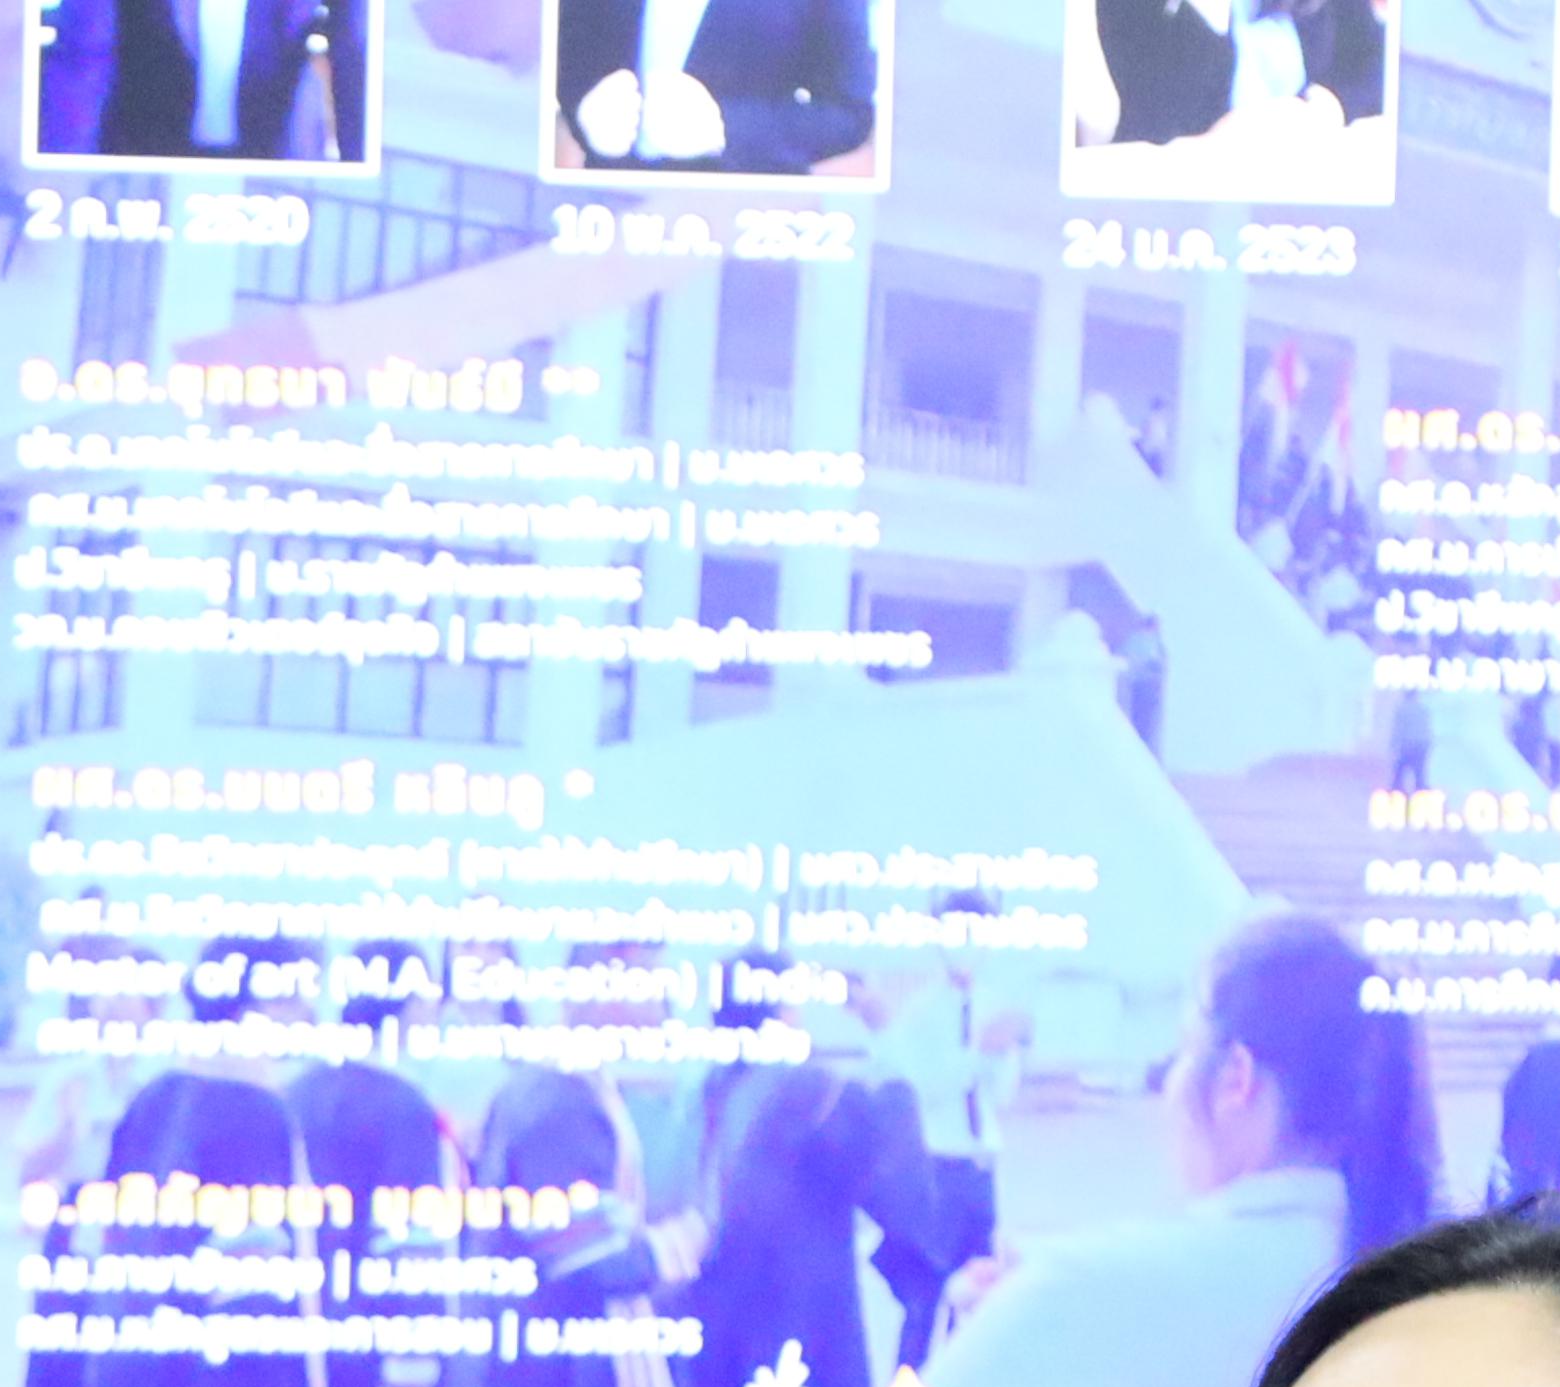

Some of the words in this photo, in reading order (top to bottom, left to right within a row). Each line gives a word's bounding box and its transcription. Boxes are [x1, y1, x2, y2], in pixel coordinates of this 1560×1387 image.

[28, 190, 61, 237] 2
[552, 205, 615, 254] 10
[1064, 219, 1125, 267] 24
[1238, 225, 1356, 273] 2523
